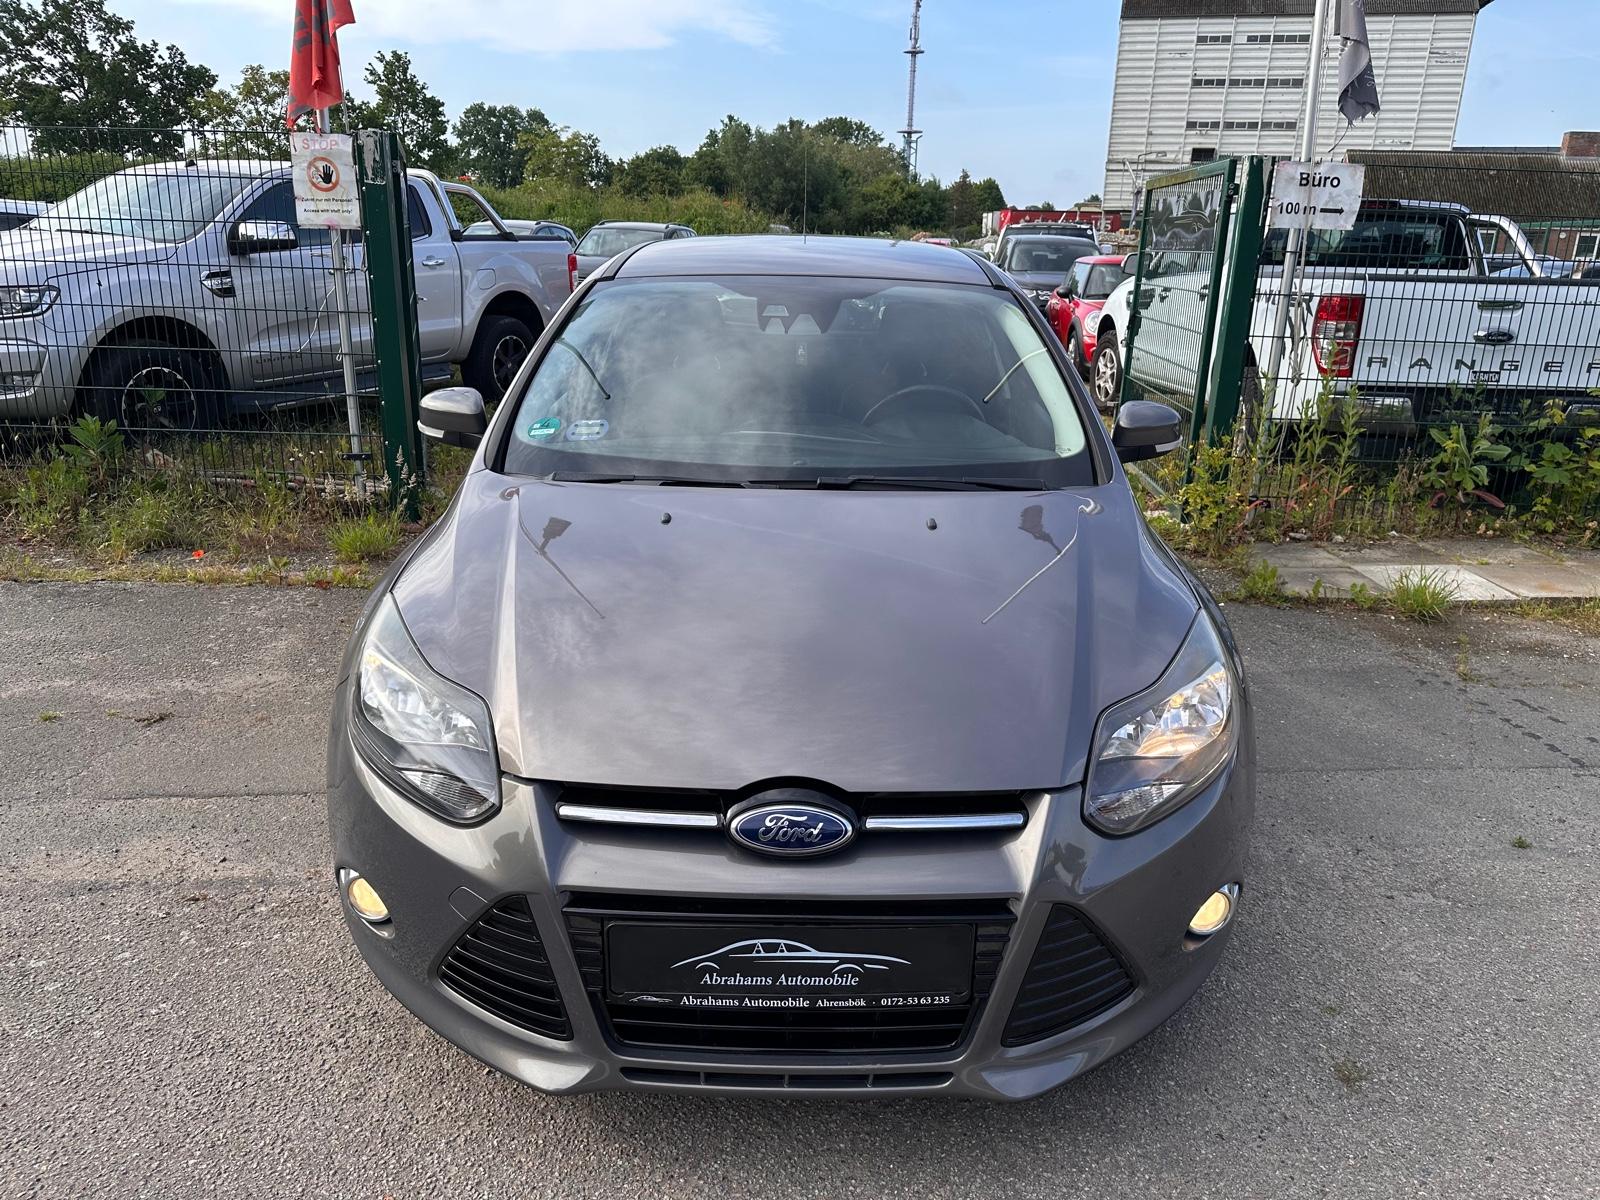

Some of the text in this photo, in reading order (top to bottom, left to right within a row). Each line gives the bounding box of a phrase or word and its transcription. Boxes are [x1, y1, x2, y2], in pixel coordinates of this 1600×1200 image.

[302, 138, 338, 151] STOP
[1299, 172, 1341, 189] Büro
[1277, 202, 1317, 216] 100 m
[758, 813, 824, 842] Ford
[701, 972, 859, 987] Abrahams Automobile
[680, 995, 950, 1008] Abrahams Automobile Ahrensbök 0172-53 63 235
